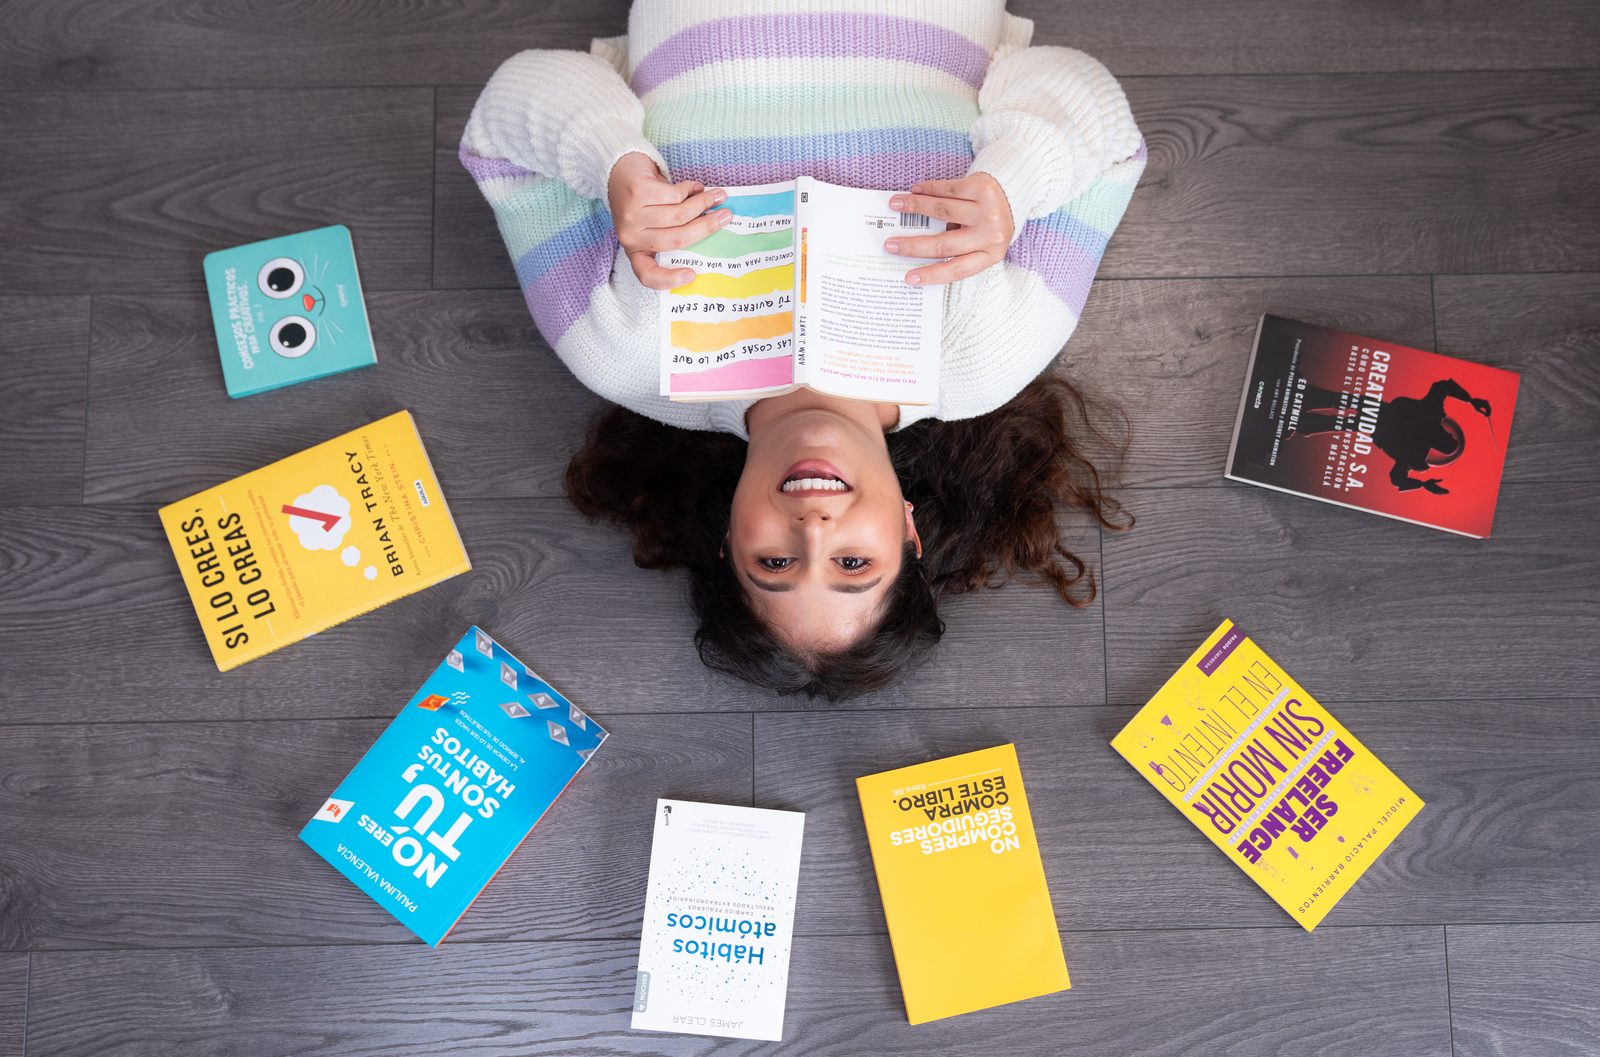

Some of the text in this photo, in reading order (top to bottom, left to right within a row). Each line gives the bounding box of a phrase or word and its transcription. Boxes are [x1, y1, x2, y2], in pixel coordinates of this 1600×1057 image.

[670, 257, 703, 266] CREATIVA
[744, 257, 760, 266] PARA
[764, 251, 793, 261] CONSEJOS
[224, 267, 254, 369] CONSEJOS PRÁCTICOS
[670, 295, 790, 313] TÚ QUIERES QUE SEAN
[247, 334, 260, 354] PARA
[672, 338, 791, 364] LAS COSAS SON LO QUE
[1346, 344, 1359, 372] HASTA
[1253, 380, 1264, 408] conecta
[1343, 375, 1352, 386] EL
[1279, 387, 1291, 415] ANIMATION
[1287, 377, 1307, 432] ED CATMULL
[1333, 390, 1349, 431] INFINITO
[1274, 419, 1284, 438] DISNEY
[1332, 347, 1370, 490] CÓMO LLEVAR LA INSPIRACIÓN
[1344, 350, 1390, 491] CREATIVIDAD, S.A.
[358, 433, 377, 461] Times
[1268, 438, 1280, 466] ANIMATION
[1327, 443, 1339, 462] MÁS
[368, 460, 385, 483] York
[1321, 464, 1334, 487] ALLÁ
[378, 482, 394, 505] New
[344, 451, 404, 576] BRIAN TRACY
[386, 503, 401, 523] The
[399, 491, 427, 545] CHRISTINA
[180, 508, 248, 649] SI LO CREES,
[217, 512, 275, 619] LO CREAS
[1203, 648, 1223, 669] EMPRESA
[1153, 659, 1283, 794] EN EL INTENTO
[1262, 695, 1327, 760] SIN
[430, 727, 515, 799] HÁBITOS
[417, 744, 500, 818] SON TUS
[892, 775, 1006, 811] ESTE LIBRO.
[1190, 736, 1288, 838] MORIR
[389, 763, 474, 862] TÚ,
[922, 791, 1008, 821] COMPRA
[1236, 738, 1355, 864] FREELANCE
[889, 805, 1012, 846] SEGUIDORES
[1289, 793, 1338, 842] SER
[357, 814, 448, 888] NO ERES
[920, 820, 1016, 854] COMPRES
[990, 834, 1020, 854] NO
[1297, 795, 1406, 914] MIGUEL PALACIO BARRIENTOS
[336, 843, 417, 912] PAULINA VALENCIA
[687, 904, 754, 916] CAMBIOS PEQUEÑOS
[731, 902, 774, 911] RESULTADOS
[666, 912, 776, 939] atómicos
[672, 938, 764, 965] Hábitos
[671, 1014, 744, 1029] JAMES CLEAR
